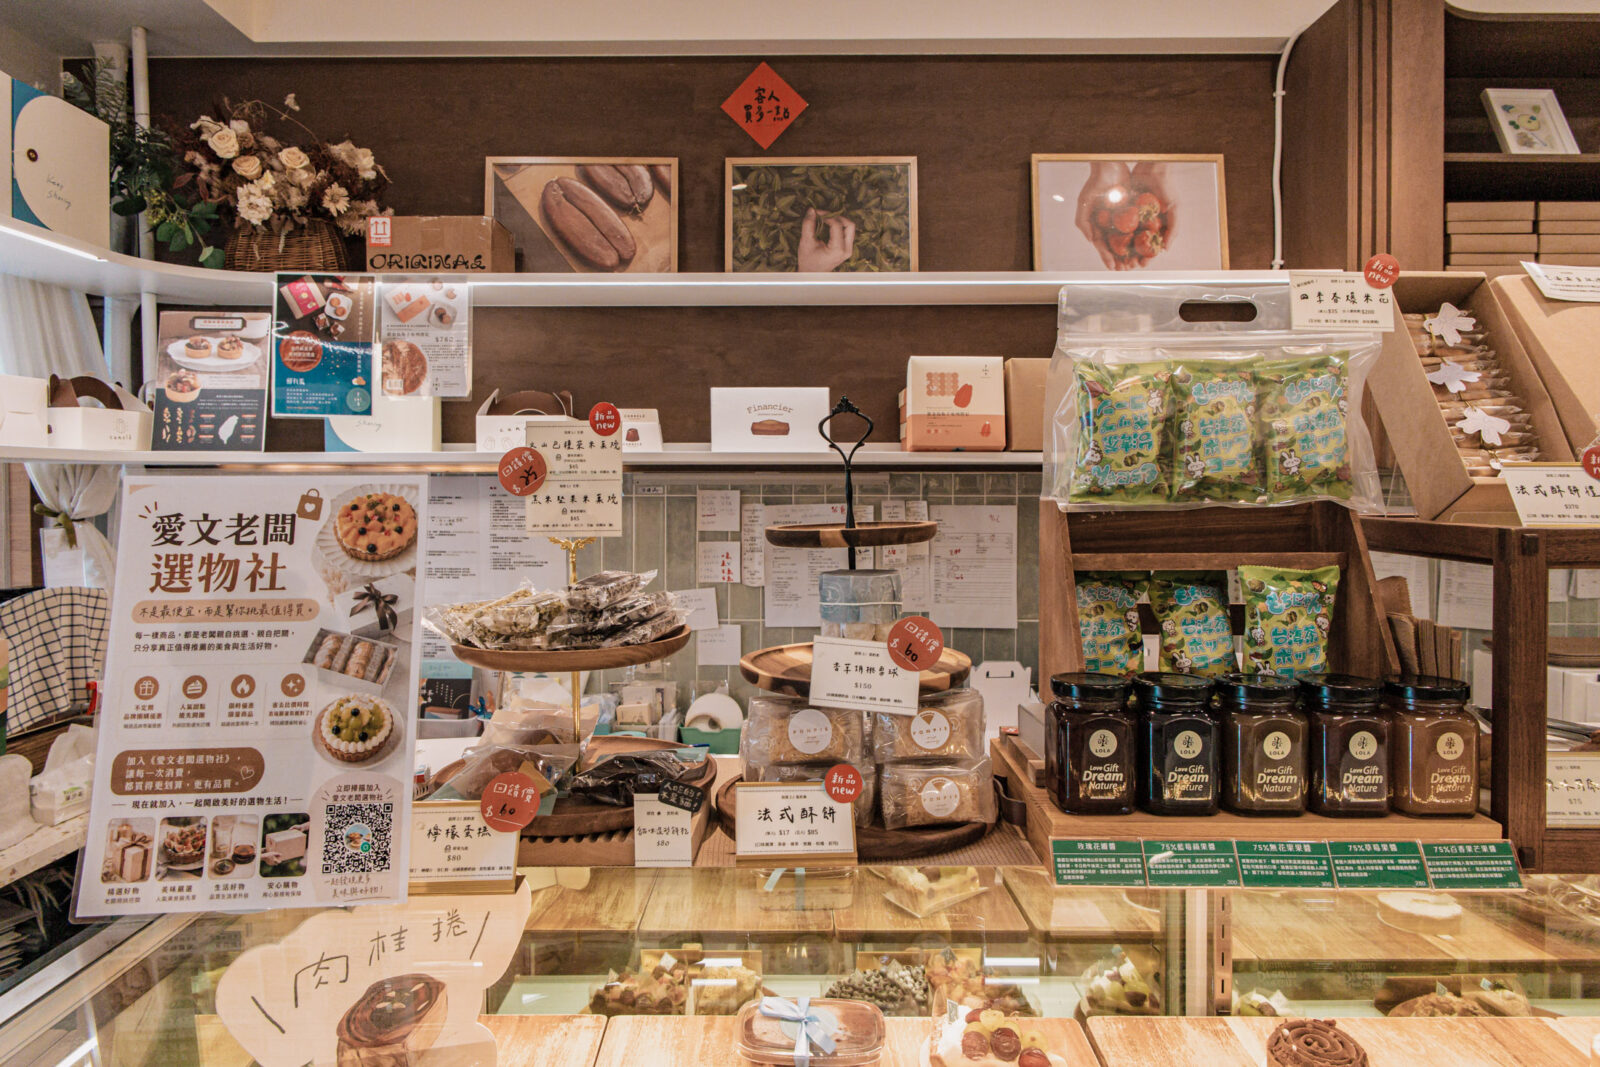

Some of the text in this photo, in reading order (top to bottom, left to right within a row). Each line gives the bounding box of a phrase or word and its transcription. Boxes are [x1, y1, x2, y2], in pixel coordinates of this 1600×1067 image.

[754, 86, 780, 104] 客人
[1373, 260, 1393, 276] 新品
[1373, 271, 1389, 284] new
[746, 403, 793, 414] Financier
[594, 410, 615, 421] 新品
[596, 422, 616, 430] new
[151, 512, 297, 547] 愛文老闆
[149, 552, 287, 593] 選物社
[905, 642, 918, 662] 60
[1103, 763, 1120, 772] Gift
[1188, 764, 1205, 774] Gift
[1277, 765, 1293, 775] Gift
[1363, 765, 1379, 775] Gift
[1451, 765, 1467, 775] Gift
[832, 772, 856, 784] 新品
[1082, 770, 1124, 781] Dream
[1167, 771, 1209, 782] Dream
[1257, 773, 1298, 784] Dream
[1342, 773, 1384, 784] Dream
[1431, 773, 1471, 784] Dream
[832, 786, 855, 796] new
[1088, 781, 1118, 790] Nature
[1174, 783, 1203, 791] Nature
[1262, 783, 1292, 792] Nature
[1349, 783, 1378, 793] Nature
[757, 805, 837, 824] 法式酥餅
[447, 854, 462, 862] $80
[295, 907, 467, 1008] 肉桂捲
